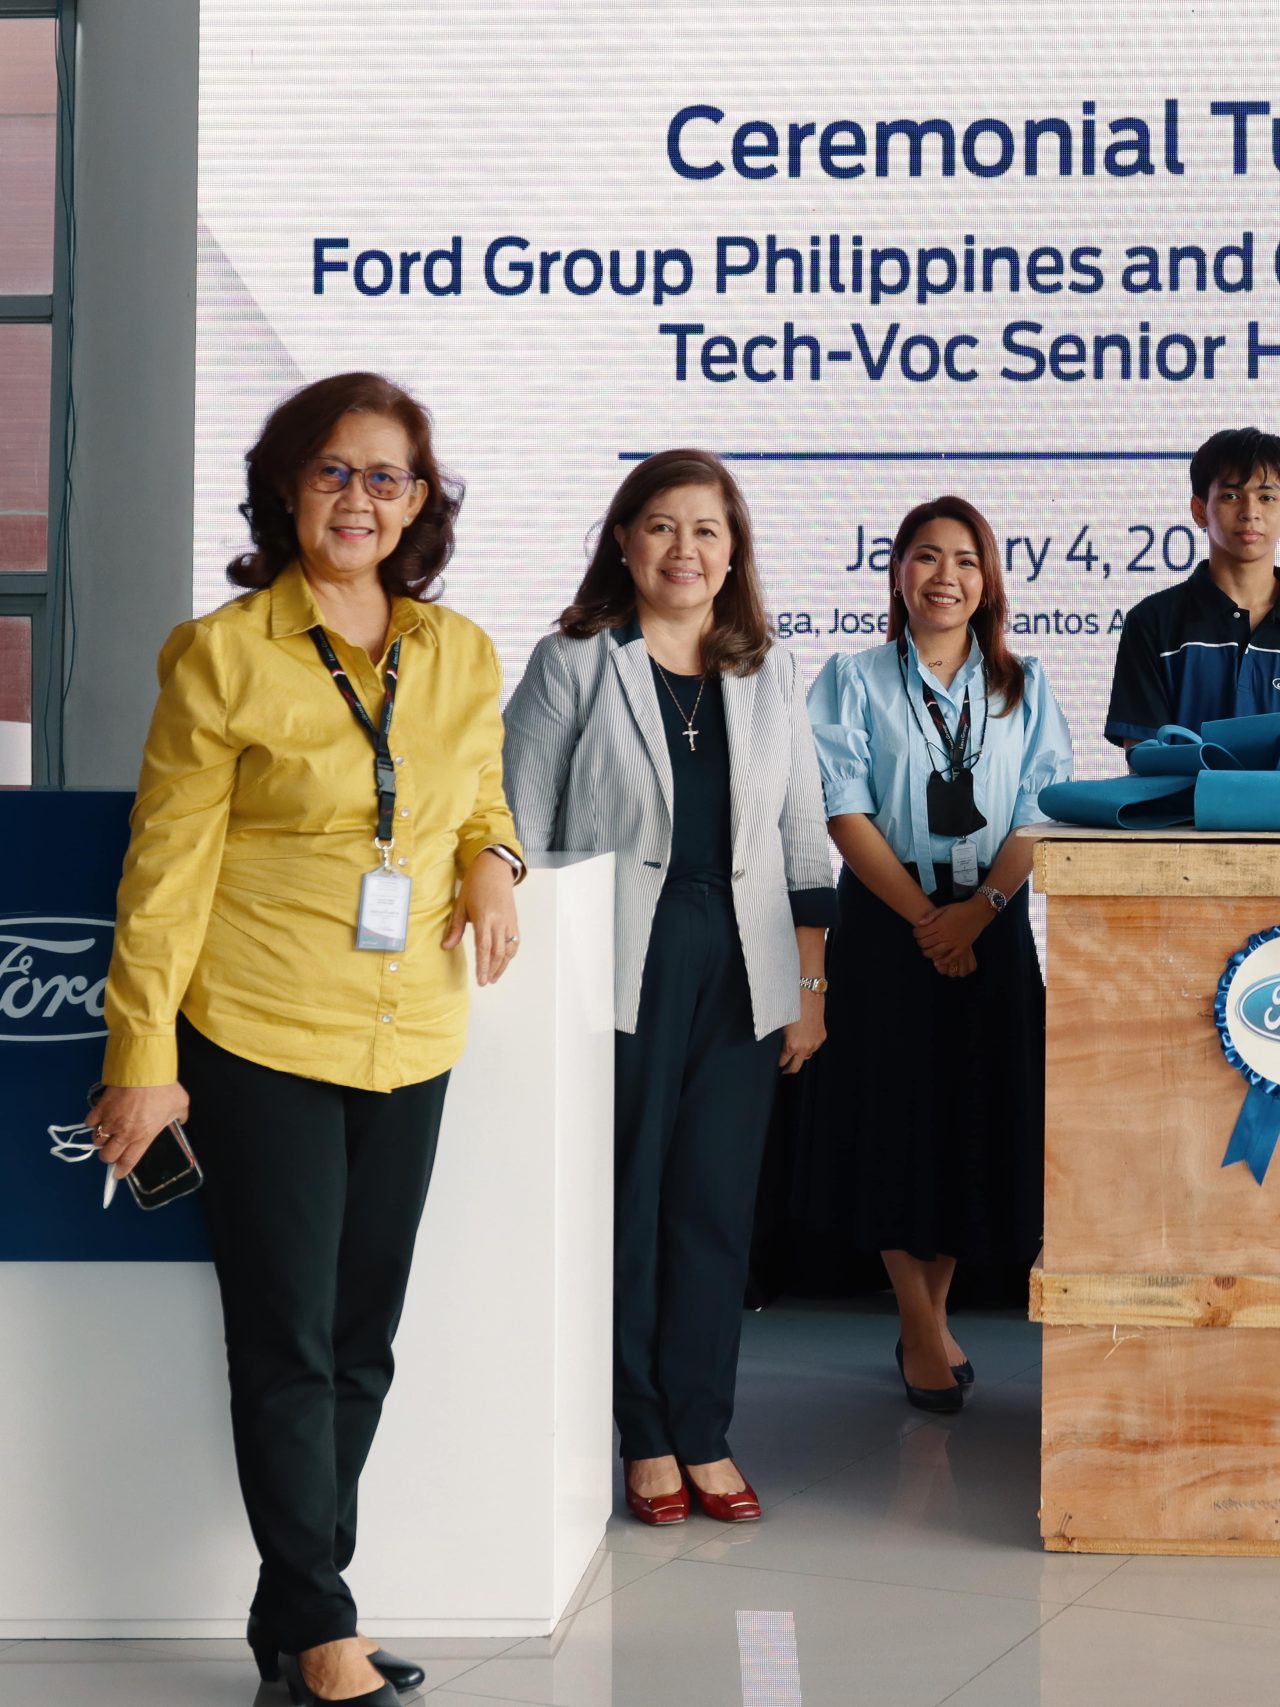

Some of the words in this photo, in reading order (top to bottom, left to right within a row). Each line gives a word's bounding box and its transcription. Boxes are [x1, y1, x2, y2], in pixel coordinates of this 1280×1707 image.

[667, 99, 1184, 180] Ceremonial
[314, 235, 461, 297] Ford
[484, 235, 693, 306] Group
[717, 234, 1103, 306] Philippines
[1122, 231, 1253, 293] and
[659, 322, 979, 383] Tech-Voc
[1000, 320, 1227, 382] Senior
[1065, 524, 1111, 579] 4,
[1008, 608, 1100, 635] antos
